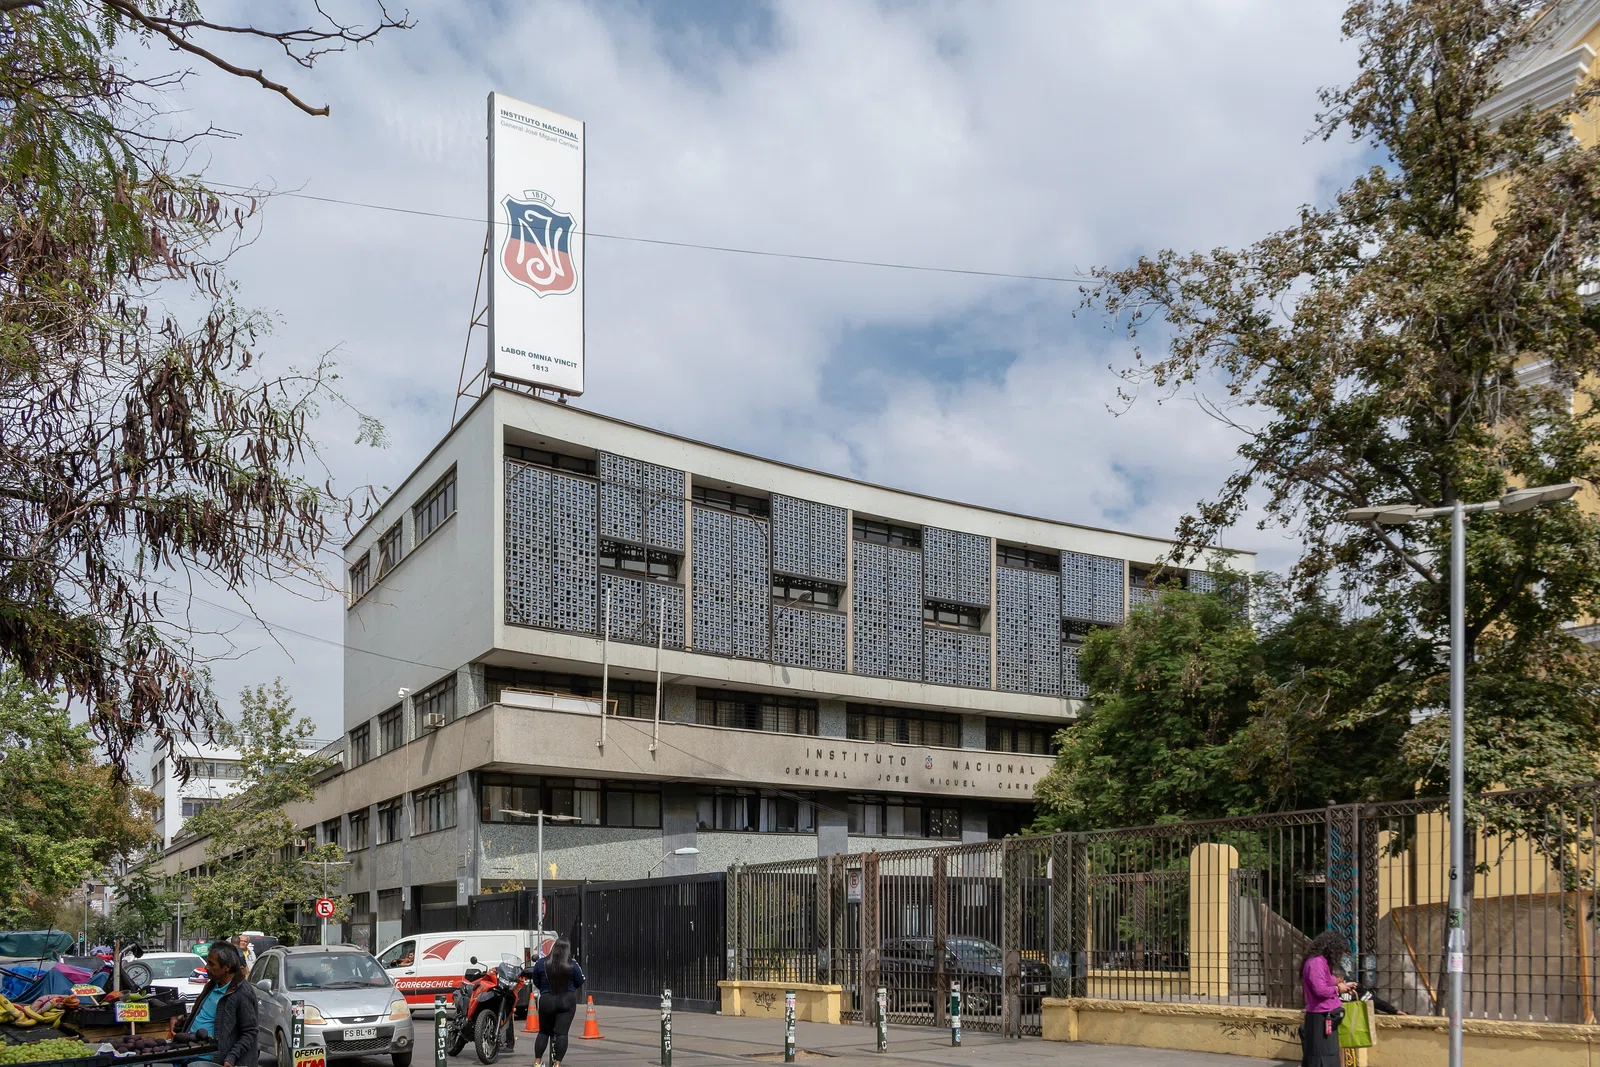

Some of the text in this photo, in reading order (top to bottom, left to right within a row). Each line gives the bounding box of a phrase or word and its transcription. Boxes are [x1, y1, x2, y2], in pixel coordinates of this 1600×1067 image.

[500, 109, 579, 140] INSTITUTO NACIONAL
[500, 120, 579, 151] General José Miguel Carrera
[532, 191, 548, 201] 1813
[501, 346, 578, 369] LABOR OMNIA VINCIT
[531, 363, 549, 373] 1813
[806, 748, 1035, 775] INSTITUTO NACIONAL
[785, 766, 848, 779] GENERAL
[877, 774, 909, 784] JOSE
[930, 778, 976, 788] MIGUEL
[395, 980, 454, 989] CORREOSCHILE
[294, 1047, 325, 1059] OFERTA
